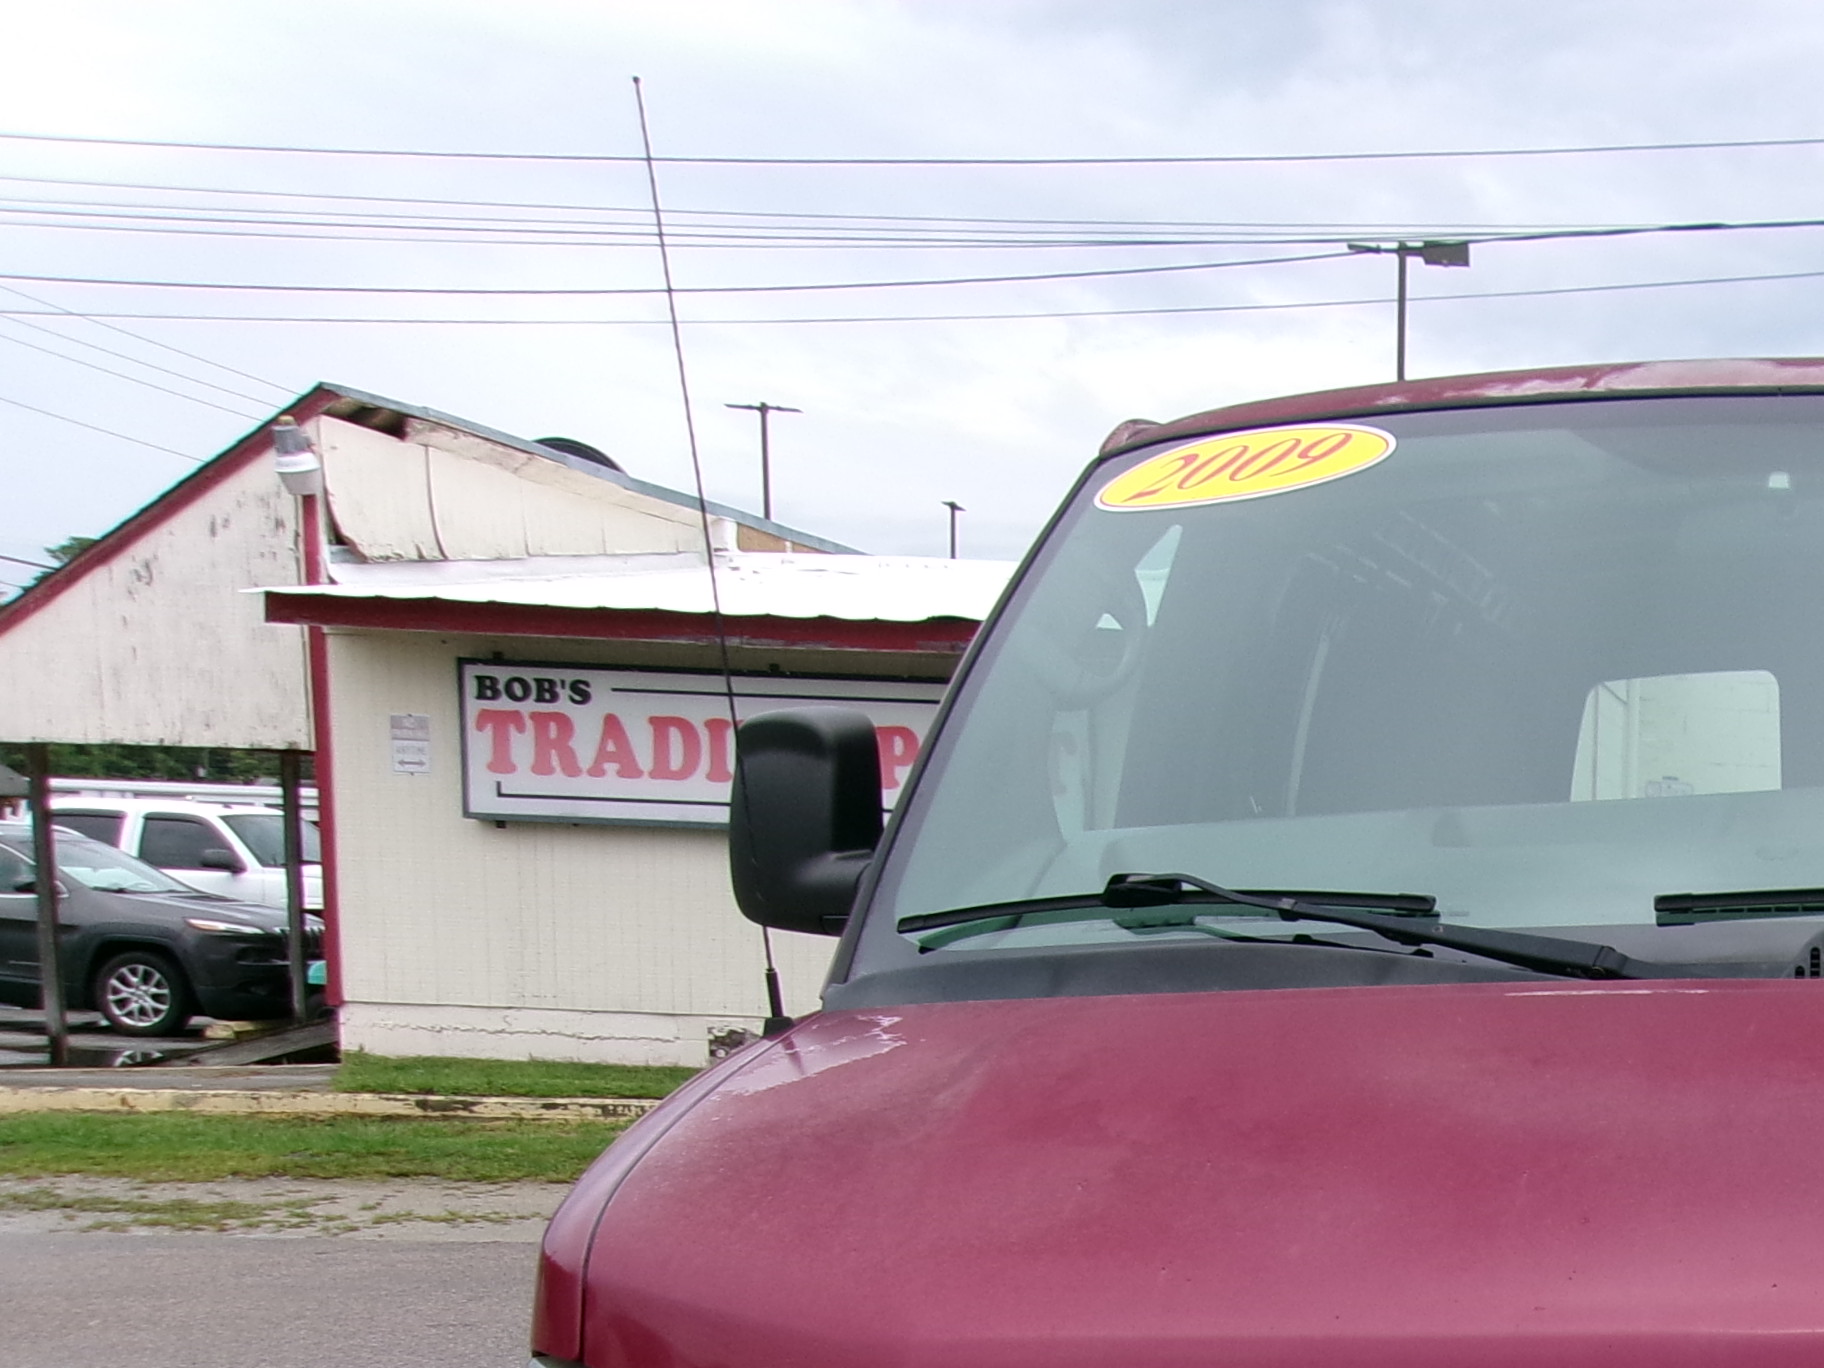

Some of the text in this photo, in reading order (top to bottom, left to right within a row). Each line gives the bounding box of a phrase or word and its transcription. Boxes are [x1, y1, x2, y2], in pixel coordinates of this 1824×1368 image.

[1121, 432, 1353, 503] 2009
[474, 675, 592, 705] BOB'S
[476, 709, 744, 782] TRADI
